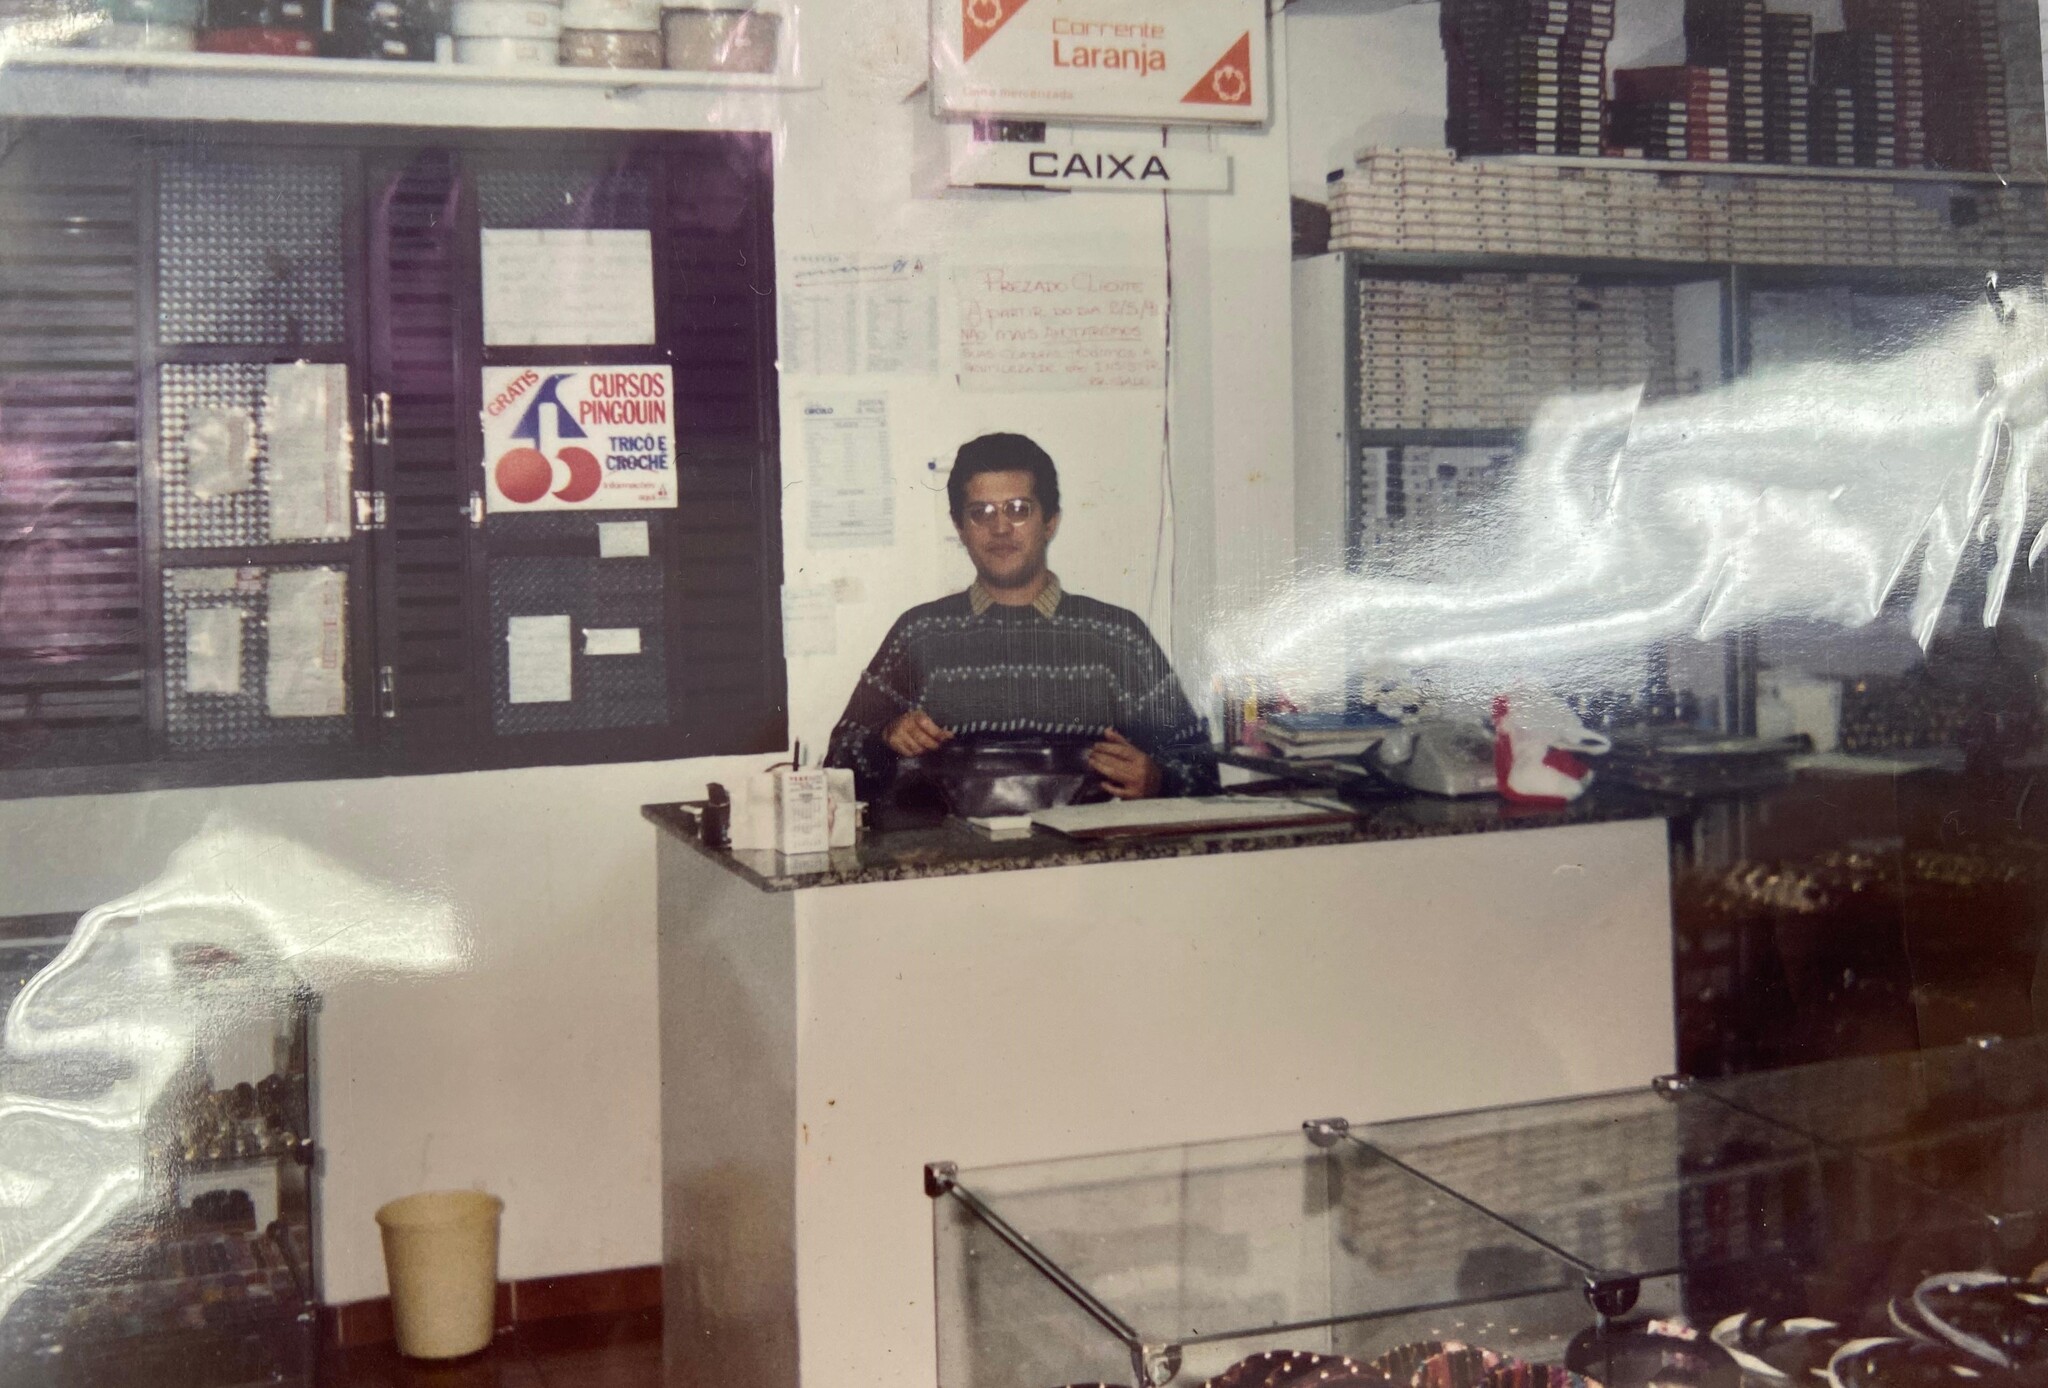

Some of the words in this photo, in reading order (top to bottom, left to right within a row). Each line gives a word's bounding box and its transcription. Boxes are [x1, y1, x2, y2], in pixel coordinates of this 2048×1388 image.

[1052, 18, 1165, 39] Corrente
[1053, 40, 1166, 77] Laranja
[1030, 152, 1170, 180] CAIXA
[590, 373, 665, 398] CURSOS
[580, 400, 666, 424] PINGOUIN
[658, 436, 667, 452] E
